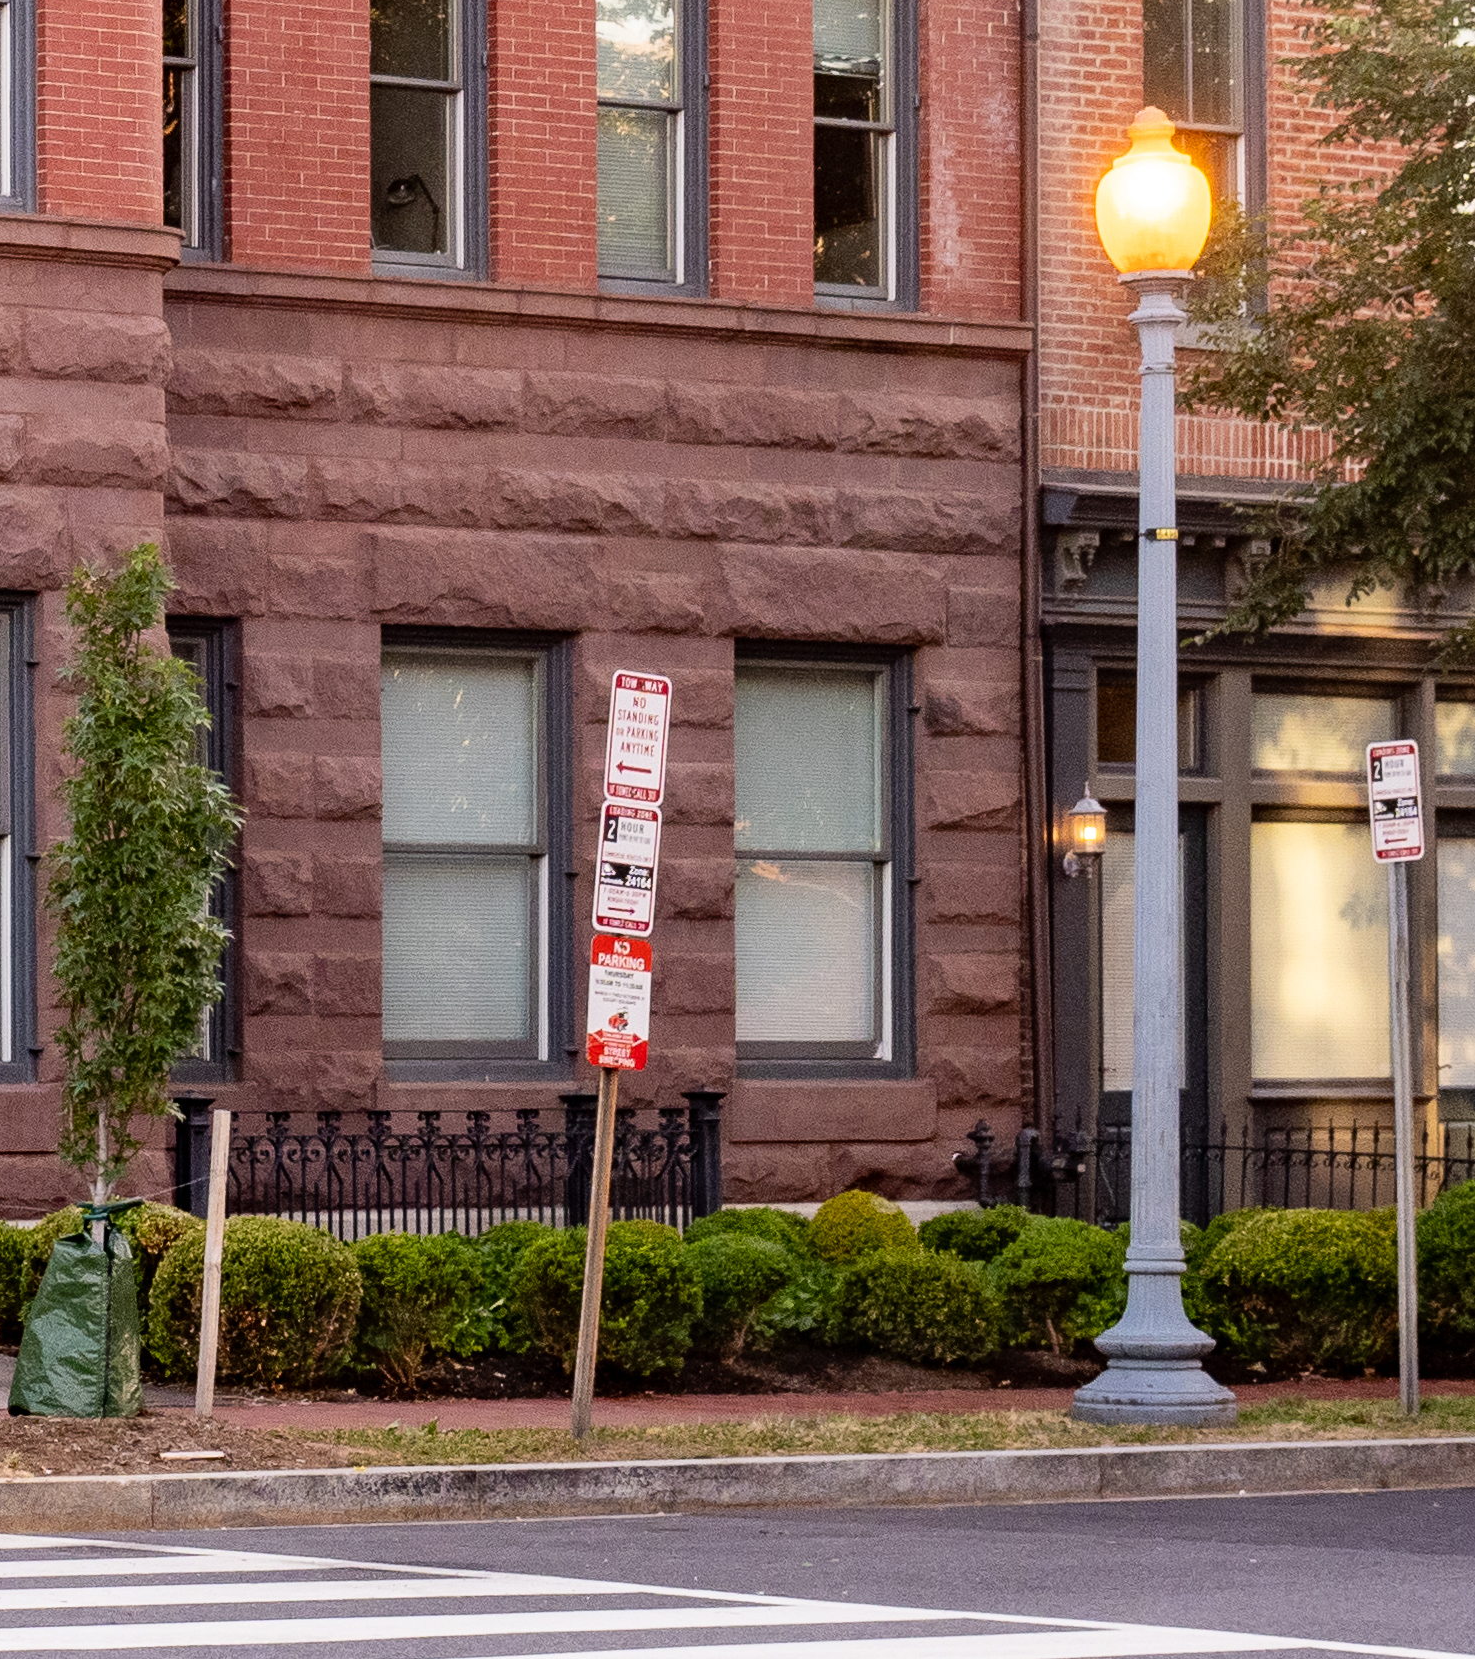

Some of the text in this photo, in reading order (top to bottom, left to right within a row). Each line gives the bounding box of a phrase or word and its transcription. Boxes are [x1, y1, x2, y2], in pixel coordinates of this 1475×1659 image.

[633, 696, 647, 709] NO
[617, 709, 659, 726] STANDING
[626, 726, 659, 741] PARKING
[620, 742, 655, 757] ANYTIME
[1374, 761, 1381, 779] 2
[607, 819, 645, 839] 2 HOUR
[614, 939, 631, 954] NO
[598, 952, 645, 971] PARKING
